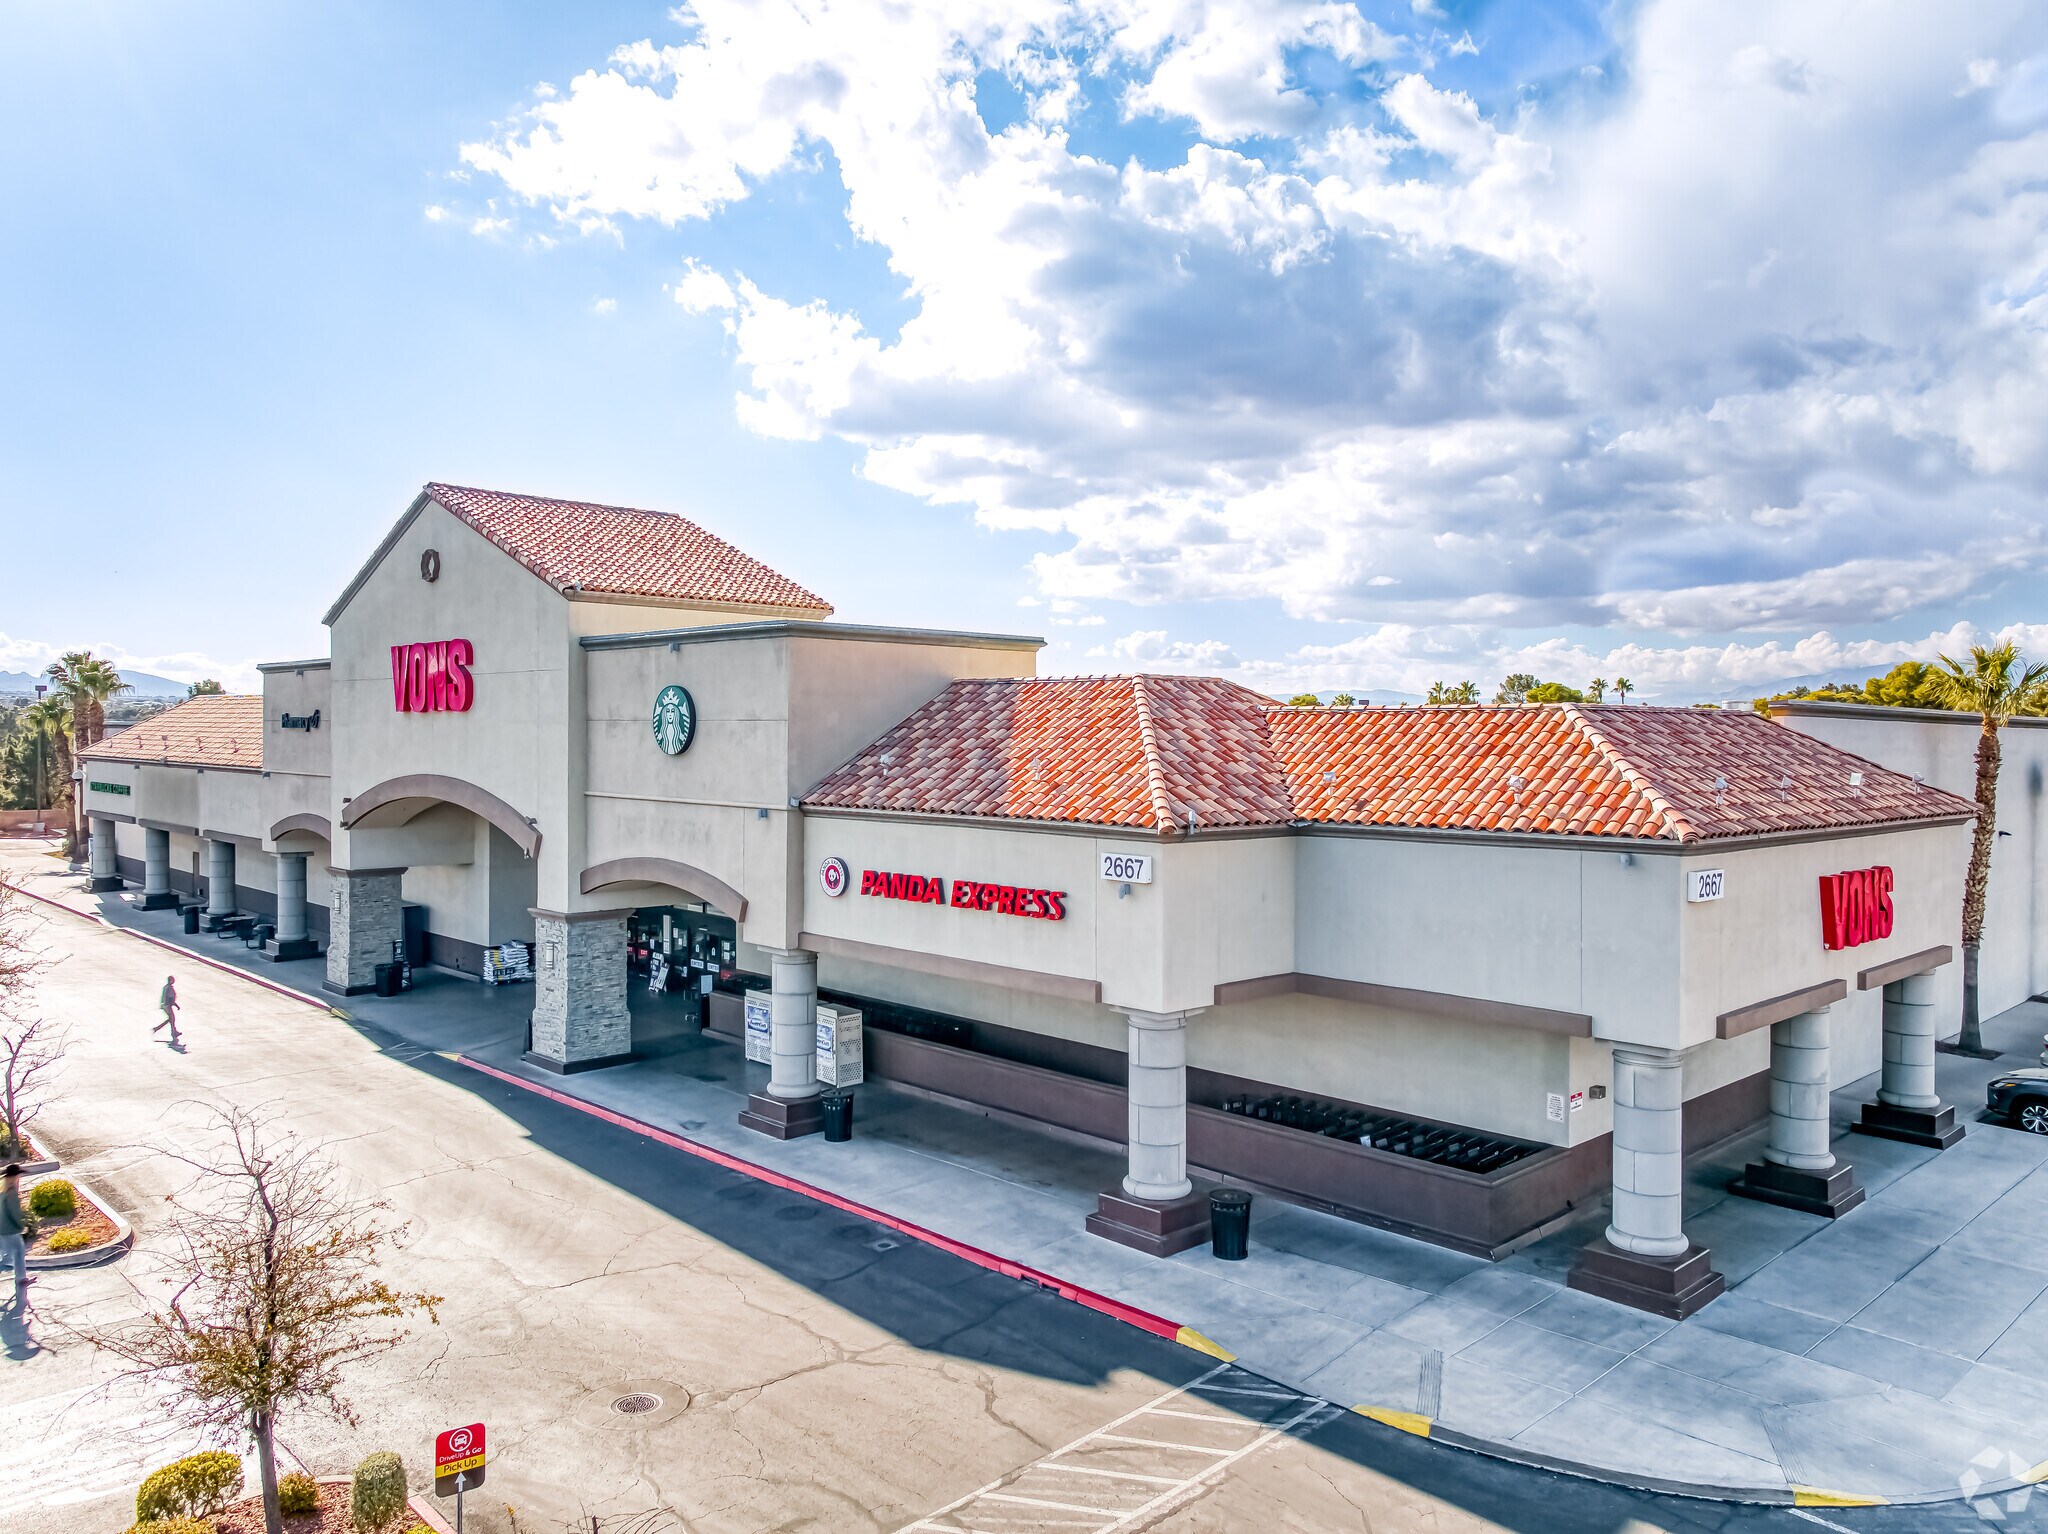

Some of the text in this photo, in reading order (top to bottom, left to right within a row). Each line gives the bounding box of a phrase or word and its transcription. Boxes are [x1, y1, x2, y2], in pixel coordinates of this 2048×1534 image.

[391, 638, 474, 712] VONS
[281, 712, 310, 733] Pharmacy
[1103, 855, 1144, 880] 2667
[860, 869, 1068, 921] PANDA EXPRESS
[1698, 872, 1723, 899] 2667
[1818, 866, 1894, 950] VONS
[439, 1452, 464, 1463] DriveUp
[443, 1458, 478, 1473] Pick Up
